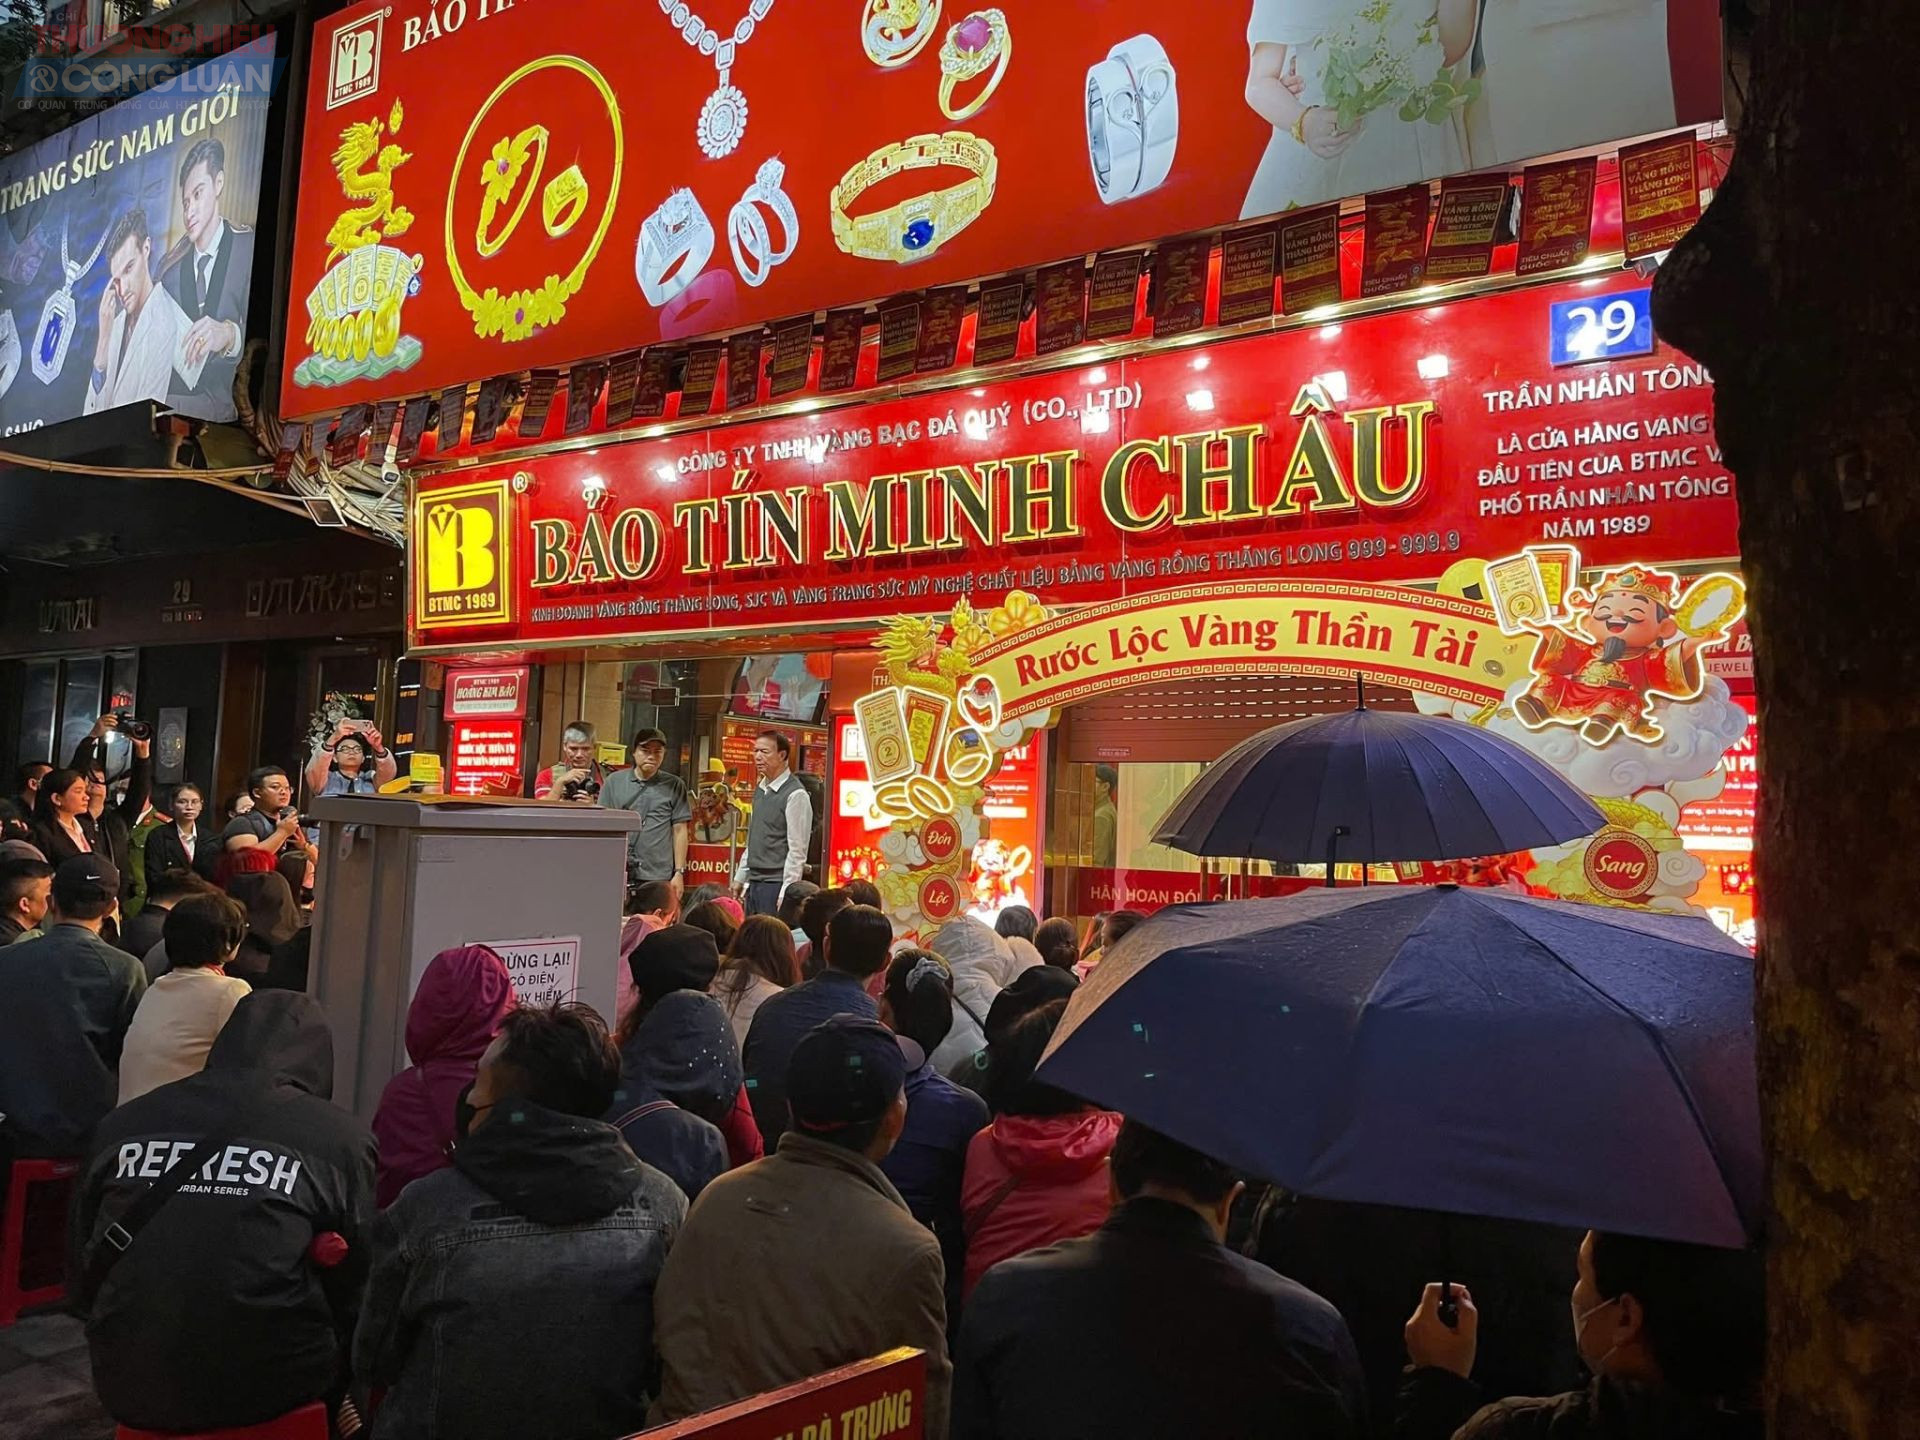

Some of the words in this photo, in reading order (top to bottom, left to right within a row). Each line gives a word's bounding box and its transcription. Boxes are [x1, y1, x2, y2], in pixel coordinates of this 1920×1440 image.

[1, 160, 67, 215] TRANG
[70, 139, 115, 185] SỨC
[119, 113, 175, 164] NAM
[180, 82, 241, 138] GIỚI
[1566, 299, 1636, 354] 29
[1483, 381, 1553, 413] TRẦN
[1559, 372, 1636, 404] NHÂN
[1642, 363, 1715, 392] TÔN
[677, 449, 728, 475] CÔNG
[732, 445, 758, 467] TY
[877, 420, 921, 447] BẠC
[928, 408, 958, 438] ĐÁ
[1497, 433, 1523, 455] LÀ
[1527, 425, 1568, 450] CỬA
[1574, 421, 1640, 446] HÀNG
[1477, 461, 1520, 488] ĐẦU
[1526, 458, 1574, 482] TIÊN
[1630, 446, 1697, 472] BTMC
[1704, 445, 1723, 463] V
[530, 488, 659, 588] BẢO
[673, 470, 807, 574] TÍN
[823, 450, 1080, 562] MINH
[1101, 384, 1435, 533] CHÂU
[1478, 491, 1523, 517] PHỐ
[1526, 484, 1586, 512] TRẦN
[1589, 480, 1656, 507] NHÂN
[1660, 475, 1729, 499] TÔNG
[1543, 517, 1595, 540] NĂM
[1600, 514, 1651, 536] 1989
[829, 583, 875, 602] TRANG
[877, 577, 905, 597] SỨC
[933, 571, 974, 595] NGHỆ
[975, 565, 1016, 591] CHẤT
[1021, 565, 1055, 589] LIỆU
[1214, 544, 1282, 570] THĂNG
[1287, 541, 1343, 566] LONG
[173, 578, 192, 604] 29
[429, 595, 461, 613] BTMC
[465, 592, 496, 609] 1989
[1014, 637, 1100, 688] Rước
[1108, 623, 1169, 664] Lộc
[1180, 612, 1279, 653] Vàng
[1290, 608, 1393, 653] Thần
[1409, 618, 1480, 670] Tài
[926, 829, 952, 845] Đón
[1595, 854, 1646, 879] Sang
[928, 889, 950, 907] Lộc
[1126, 887, 1169, 904] HOAN
[543, 951, 571, 970] LẠI!
[510, 972, 526, 987] CÓ
[213, 1185, 249, 1197] SERIES
